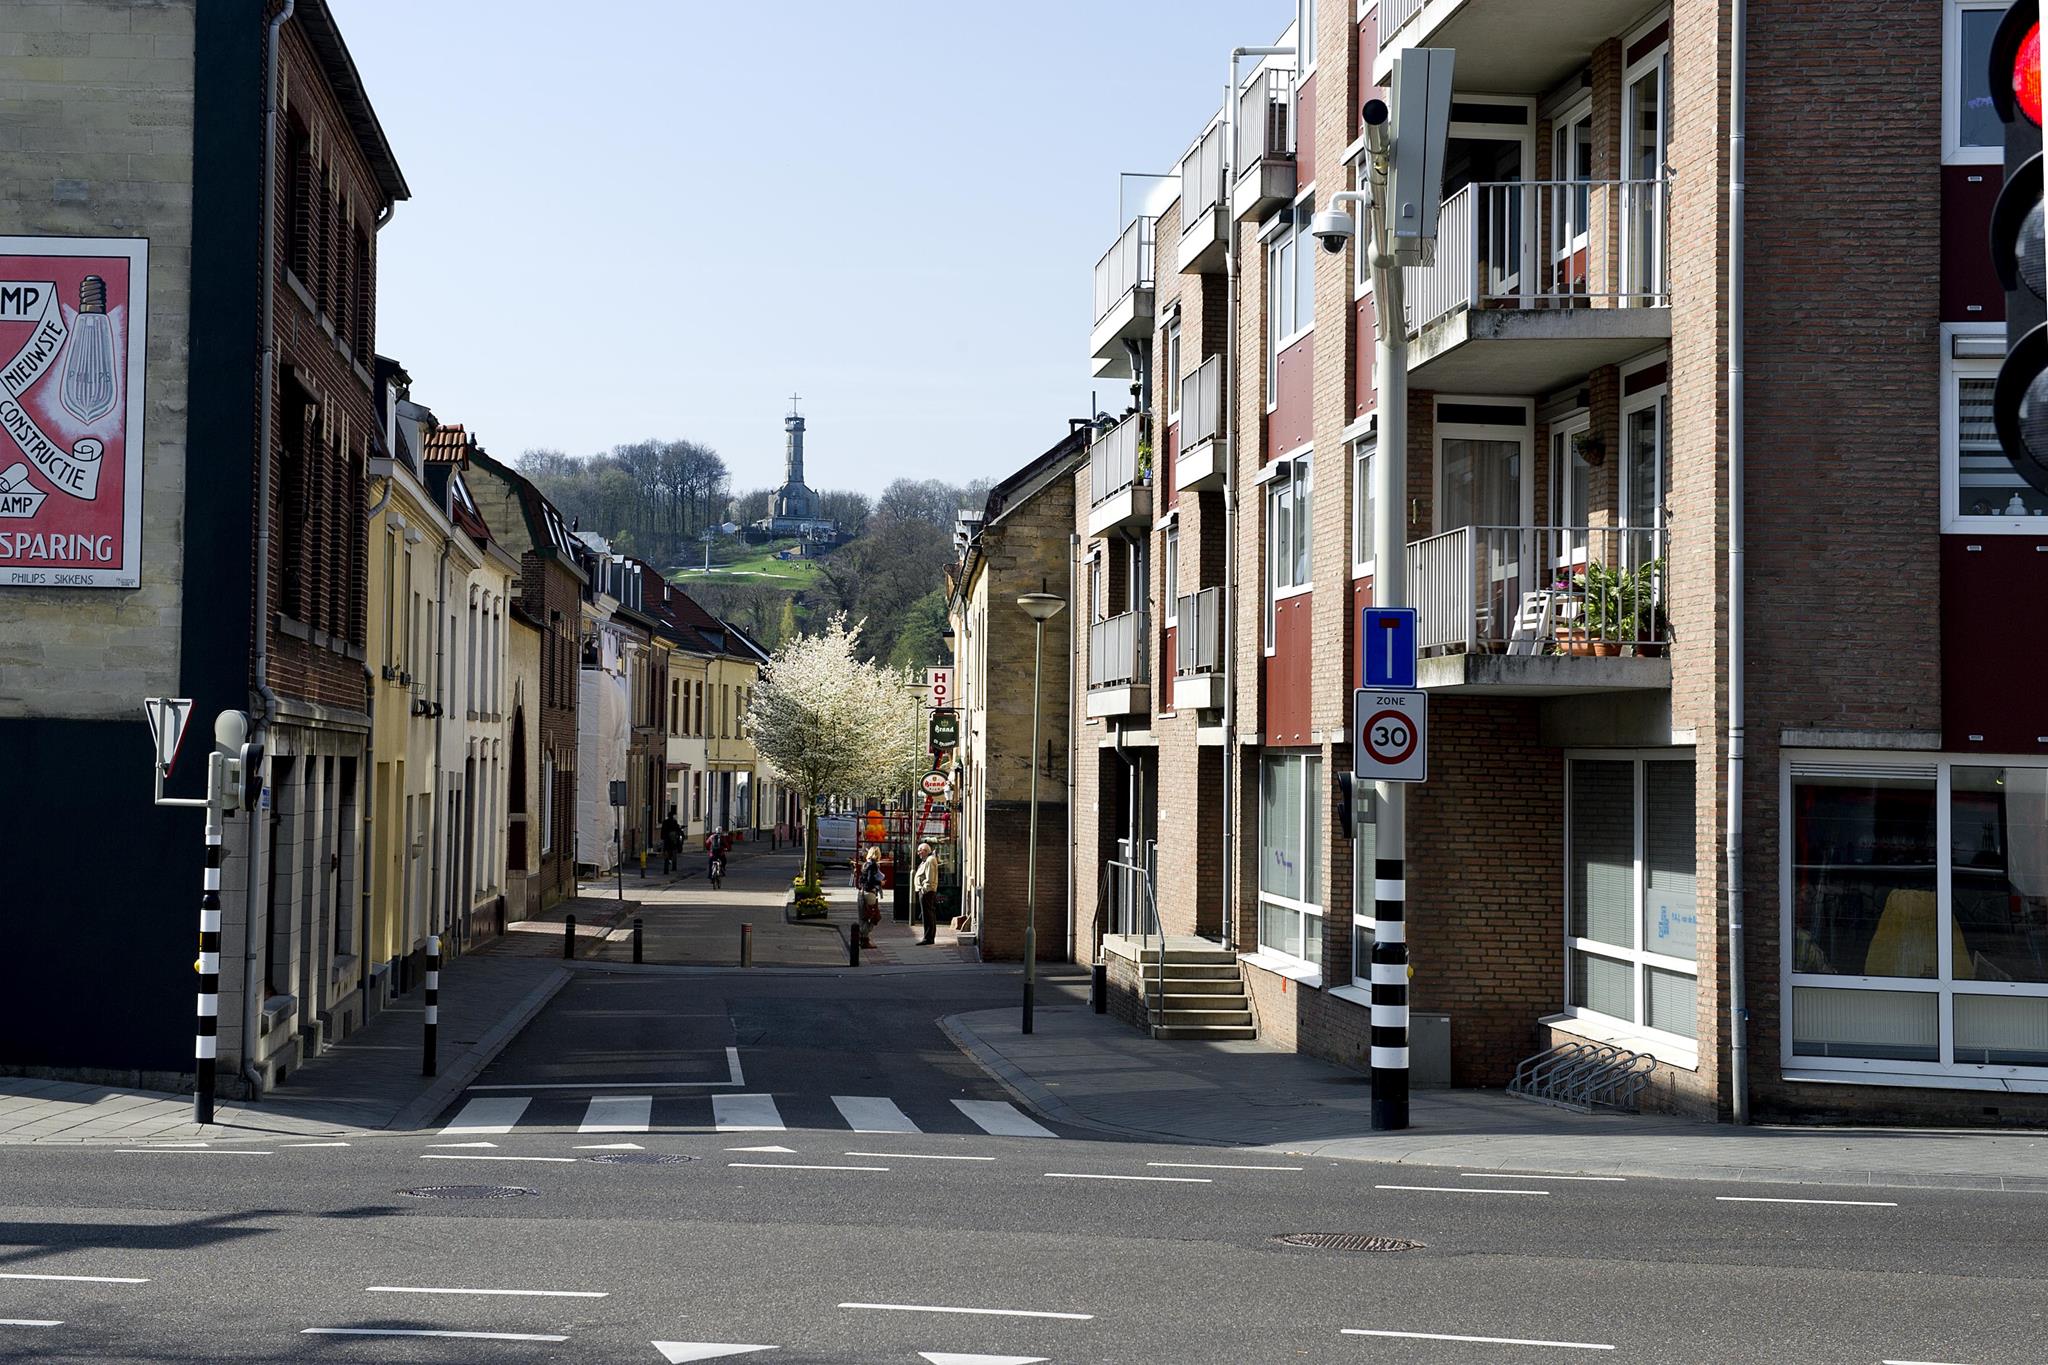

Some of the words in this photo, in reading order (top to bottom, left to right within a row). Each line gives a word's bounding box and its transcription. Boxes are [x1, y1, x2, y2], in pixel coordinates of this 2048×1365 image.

[4, 320, 62, 390] NIEUWSTE
[69, 371, 112, 384] PHILIPS
[0, 400, 86, 490] CONSTRUCTIE
[11, 573, 46, 584] PHILIPS
[54, 574, 94, 585] SIKKENS
[1376, 696, 1406, 705] ZONE
[934, 724, 954, 733] Brand
[1373, 726, 1408, 747] 30
[925, 780, 944, 788] Brand
